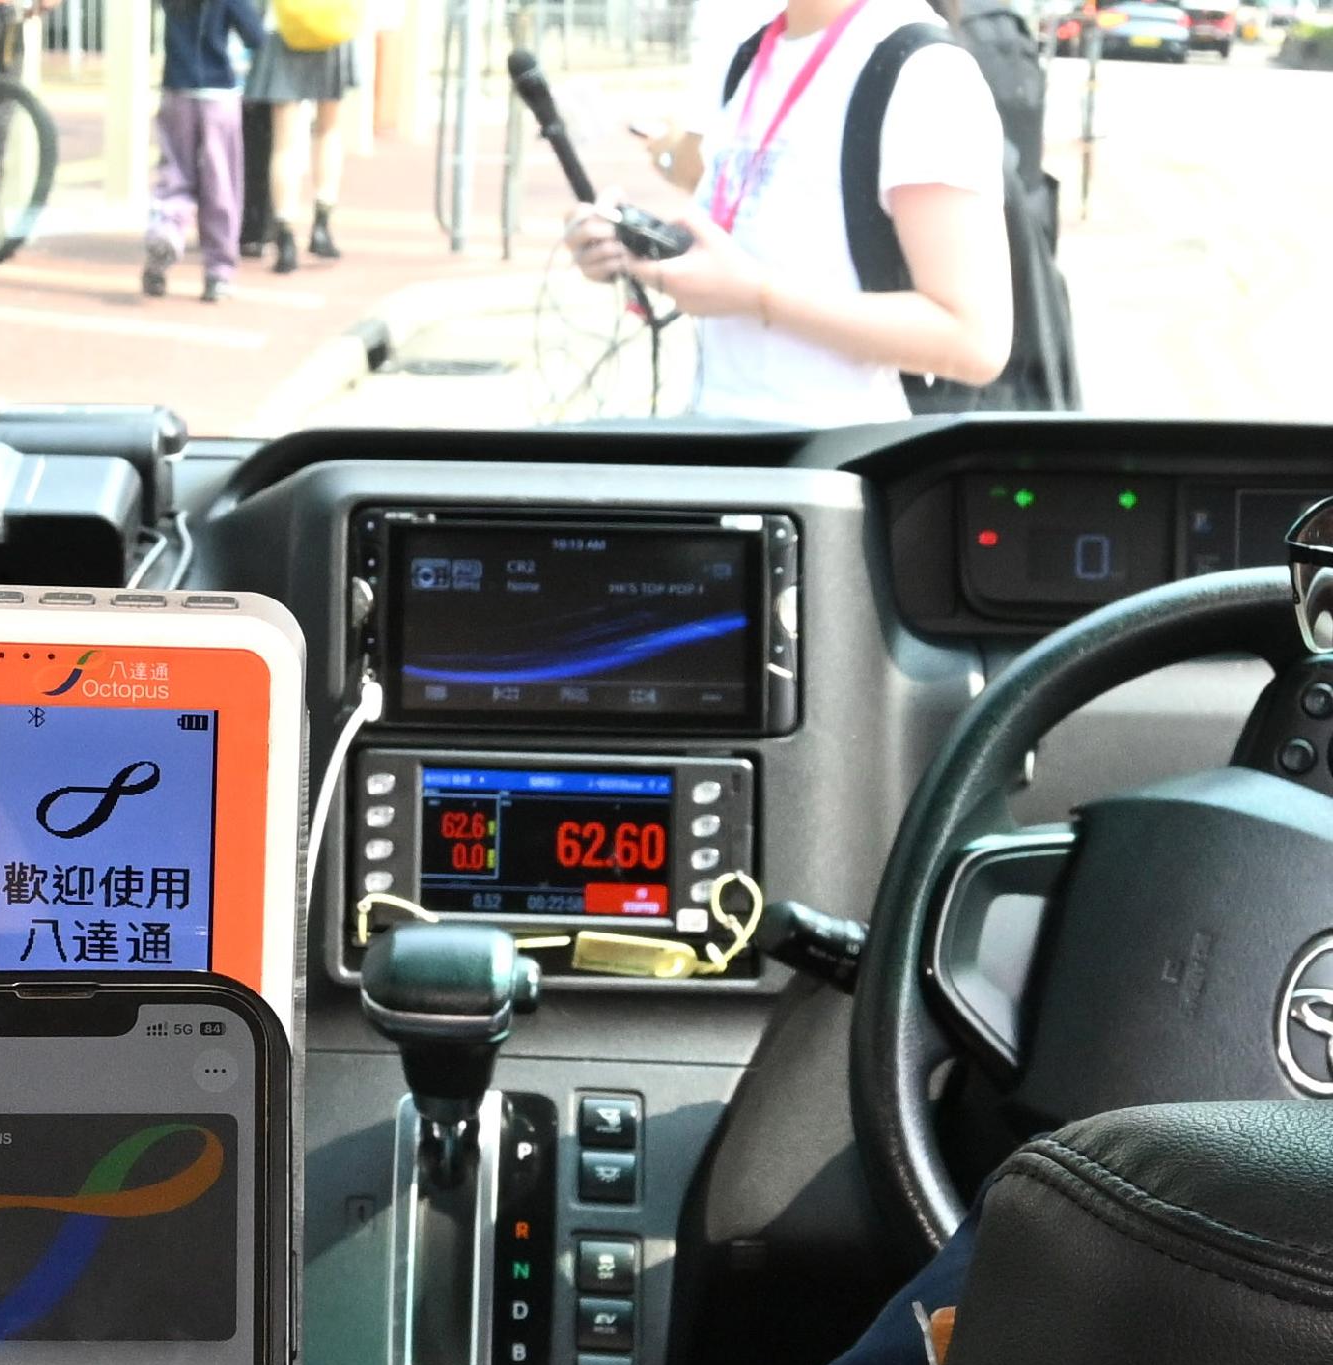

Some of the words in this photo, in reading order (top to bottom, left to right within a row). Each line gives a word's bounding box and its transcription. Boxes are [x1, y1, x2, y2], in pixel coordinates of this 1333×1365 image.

[109, 660, 169, 681] 八達通
[82, 680, 170, 703] Octopus
[441, 811, 485, 838] 62.6
[557, 821, 665, 870] 62.60
[452, 843, 484, 870] 0.0
[2, 861, 191, 910] 歡迎使用
[20, 918, 173, 964] 八達通
[173, 1022, 193, 1036] 5G
[204, 1023, 222, 1035] 84
[517, 1142, 532, 1159] P
[515, 1223, 529, 1239] R
[514, 1263, 529, 1279] N
[513, 1302, 528, 1319] D
[512, 1344, 526, 1361] B
